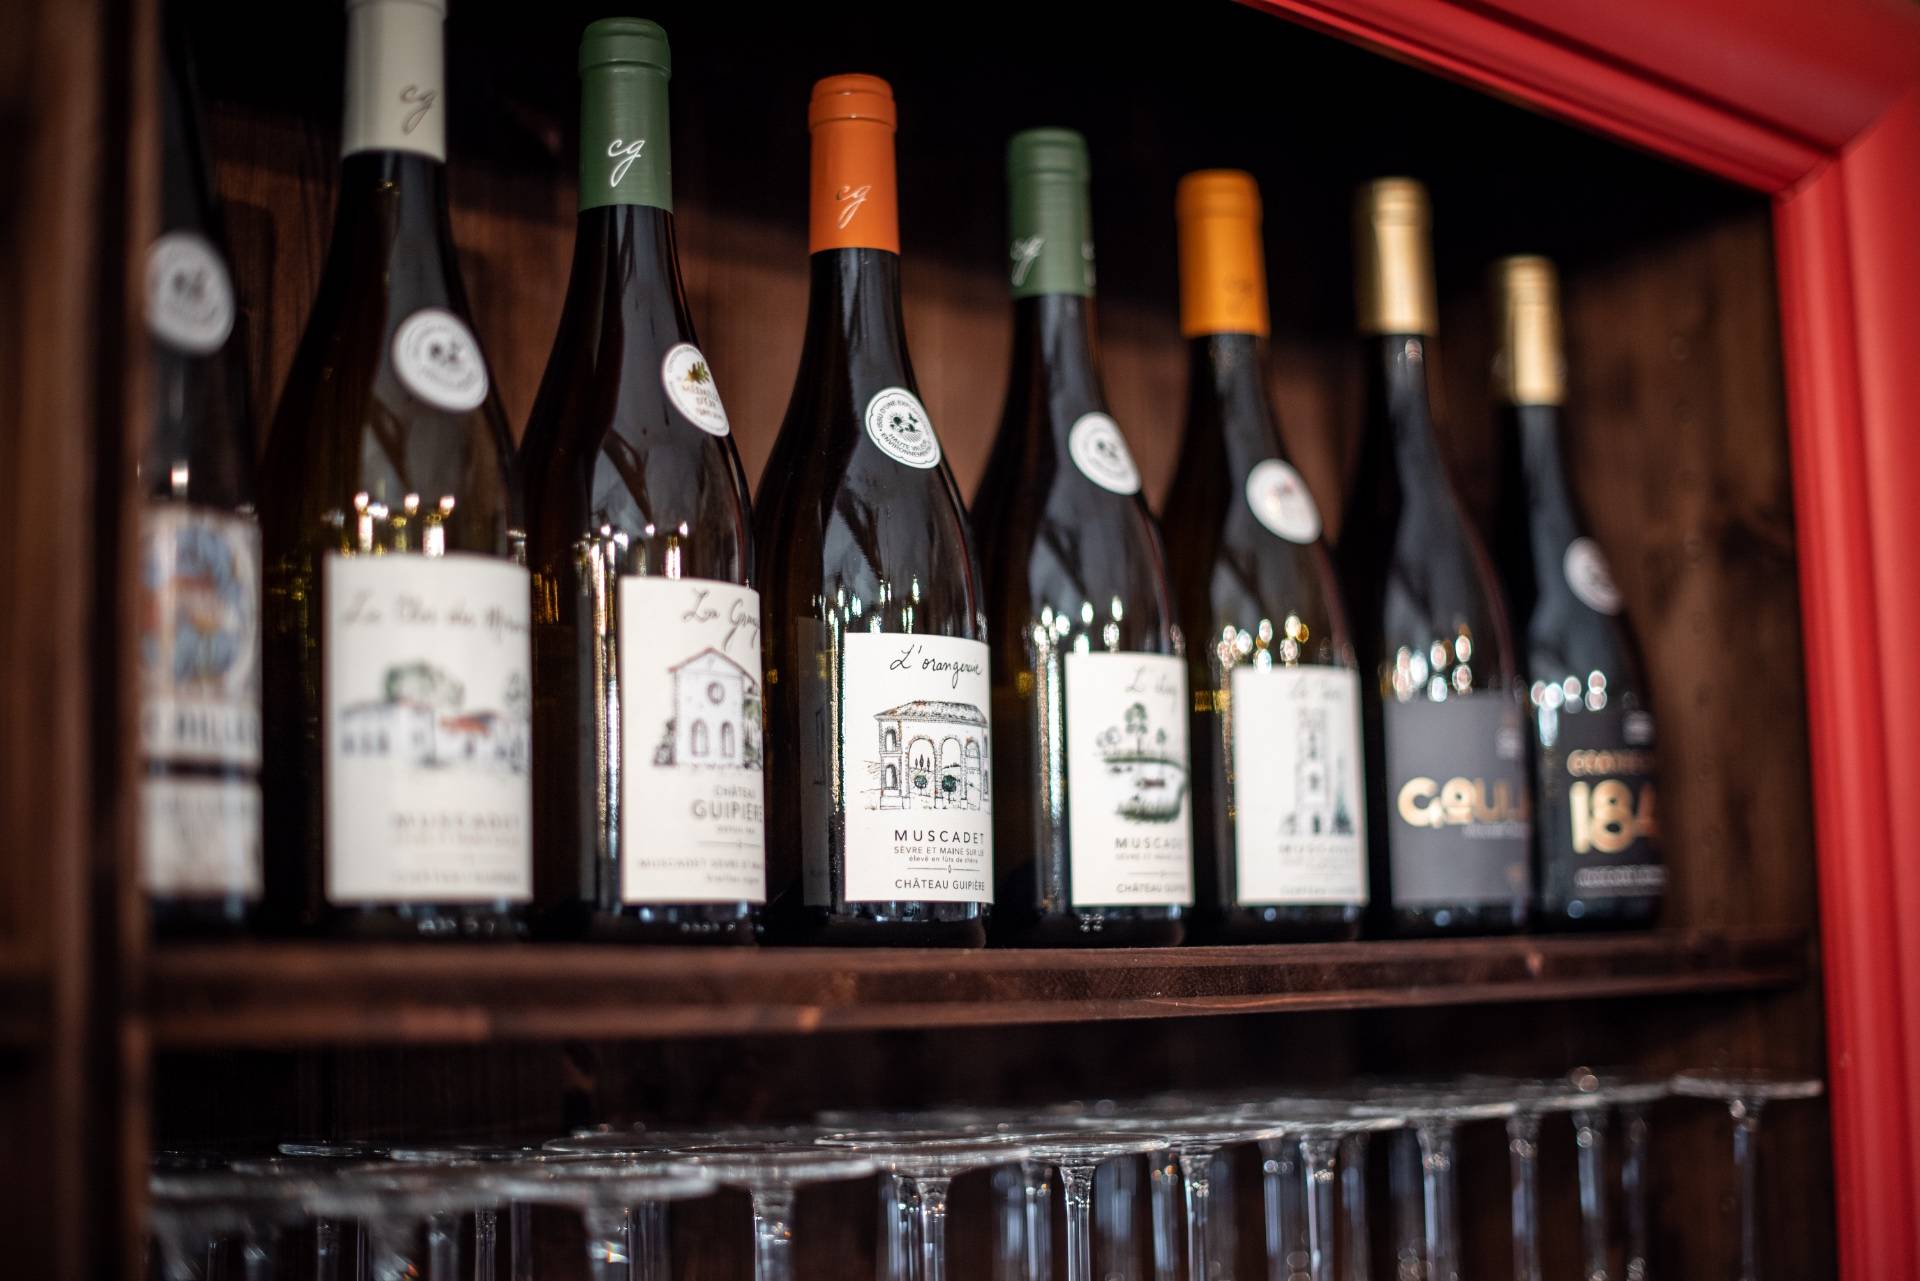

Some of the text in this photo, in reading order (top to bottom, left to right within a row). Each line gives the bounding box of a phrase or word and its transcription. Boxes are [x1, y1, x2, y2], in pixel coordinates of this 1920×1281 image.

[607, 139, 646, 188] cg
[895, 829, 985, 844] MUSCADET
[926, 846, 937, 855] ET
[939, 846, 965, 856] MAINE
[894, 877, 949, 889] CHÂTEAU
